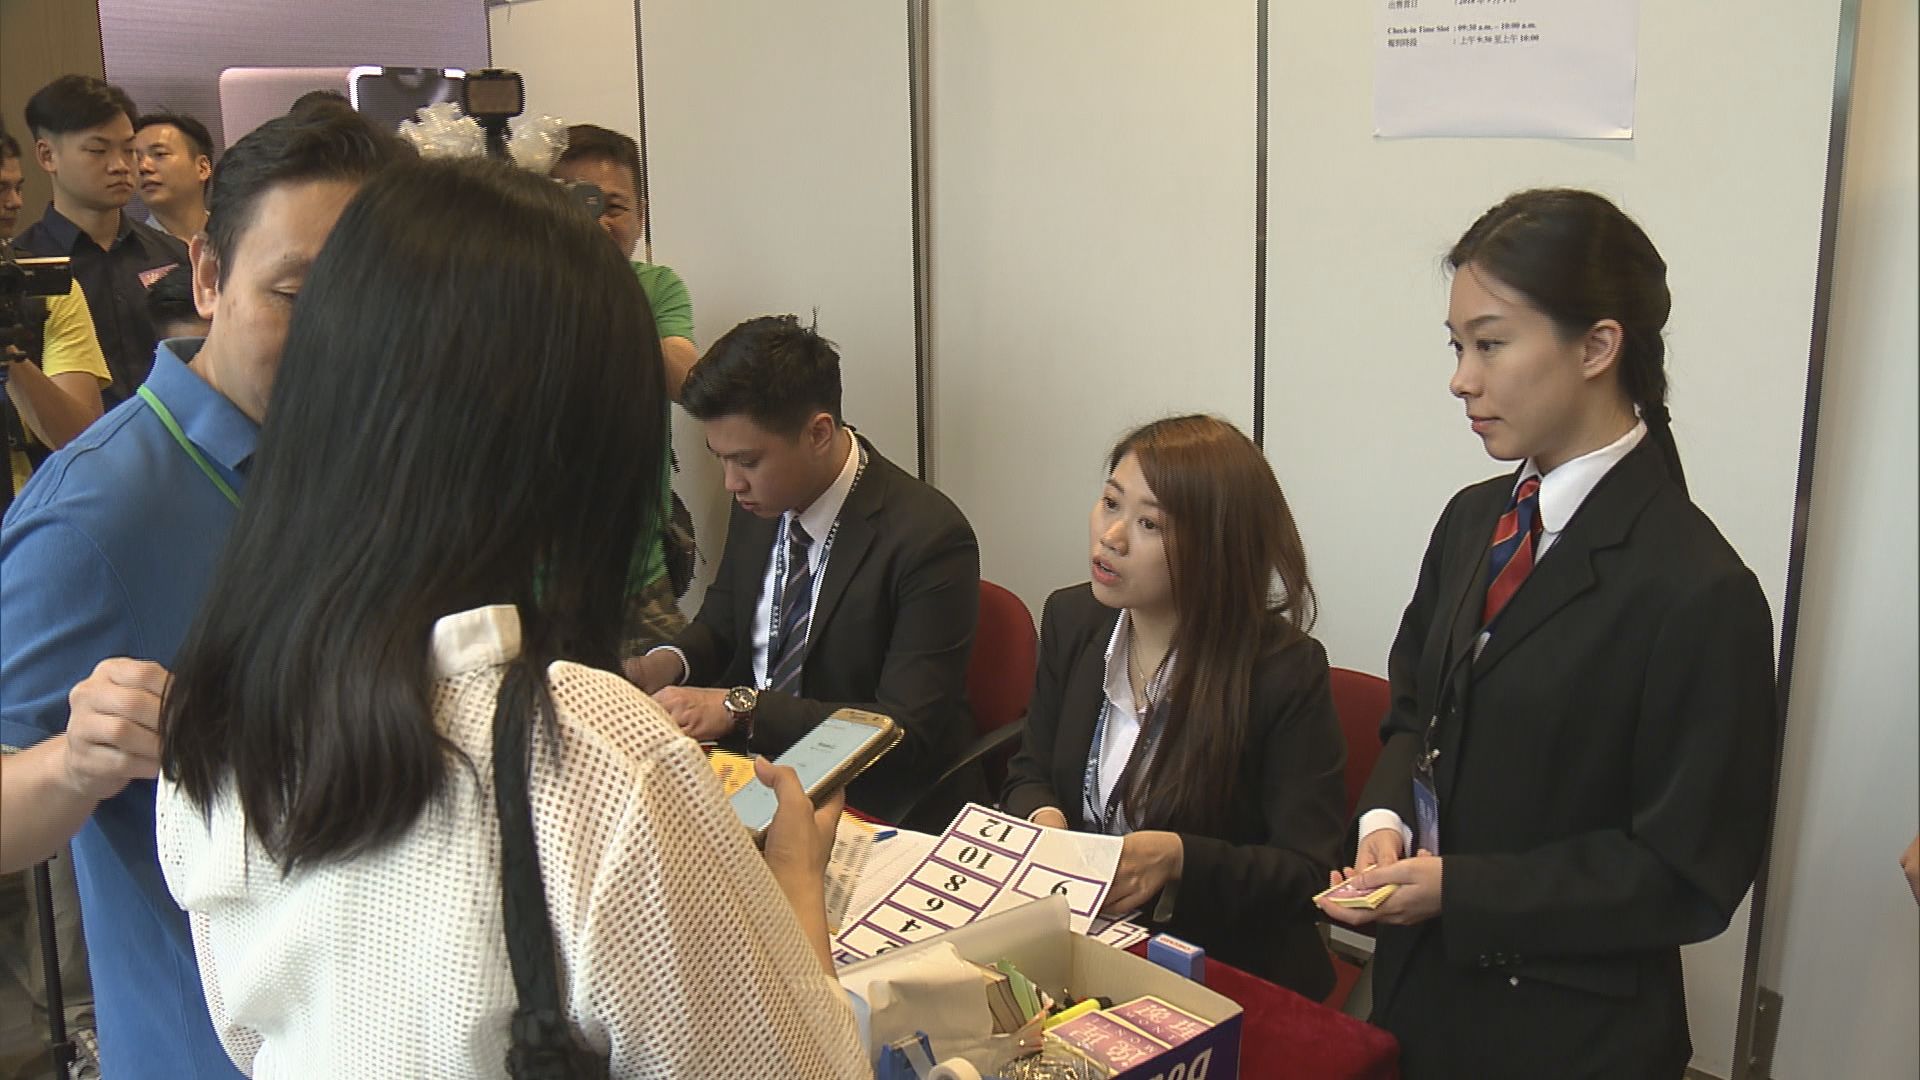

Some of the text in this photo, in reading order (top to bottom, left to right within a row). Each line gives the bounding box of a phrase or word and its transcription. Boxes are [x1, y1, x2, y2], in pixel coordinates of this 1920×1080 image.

[1387, 26, 1417, 34] Check-in
[1419, 25, 1434, 33] Time
[1436, 24, 1449, 32] Slot
[1457, 23, 1477, 31] 09:30
[1501, 22, 1520, 30] 10:00
[978, 818, 1014, 843] 12
[957, 846, 993, 870] 10
[943, 874, 967, 892] 8
[921, 897, 945, 912] 6
[898, 918, 922, 933] 4
